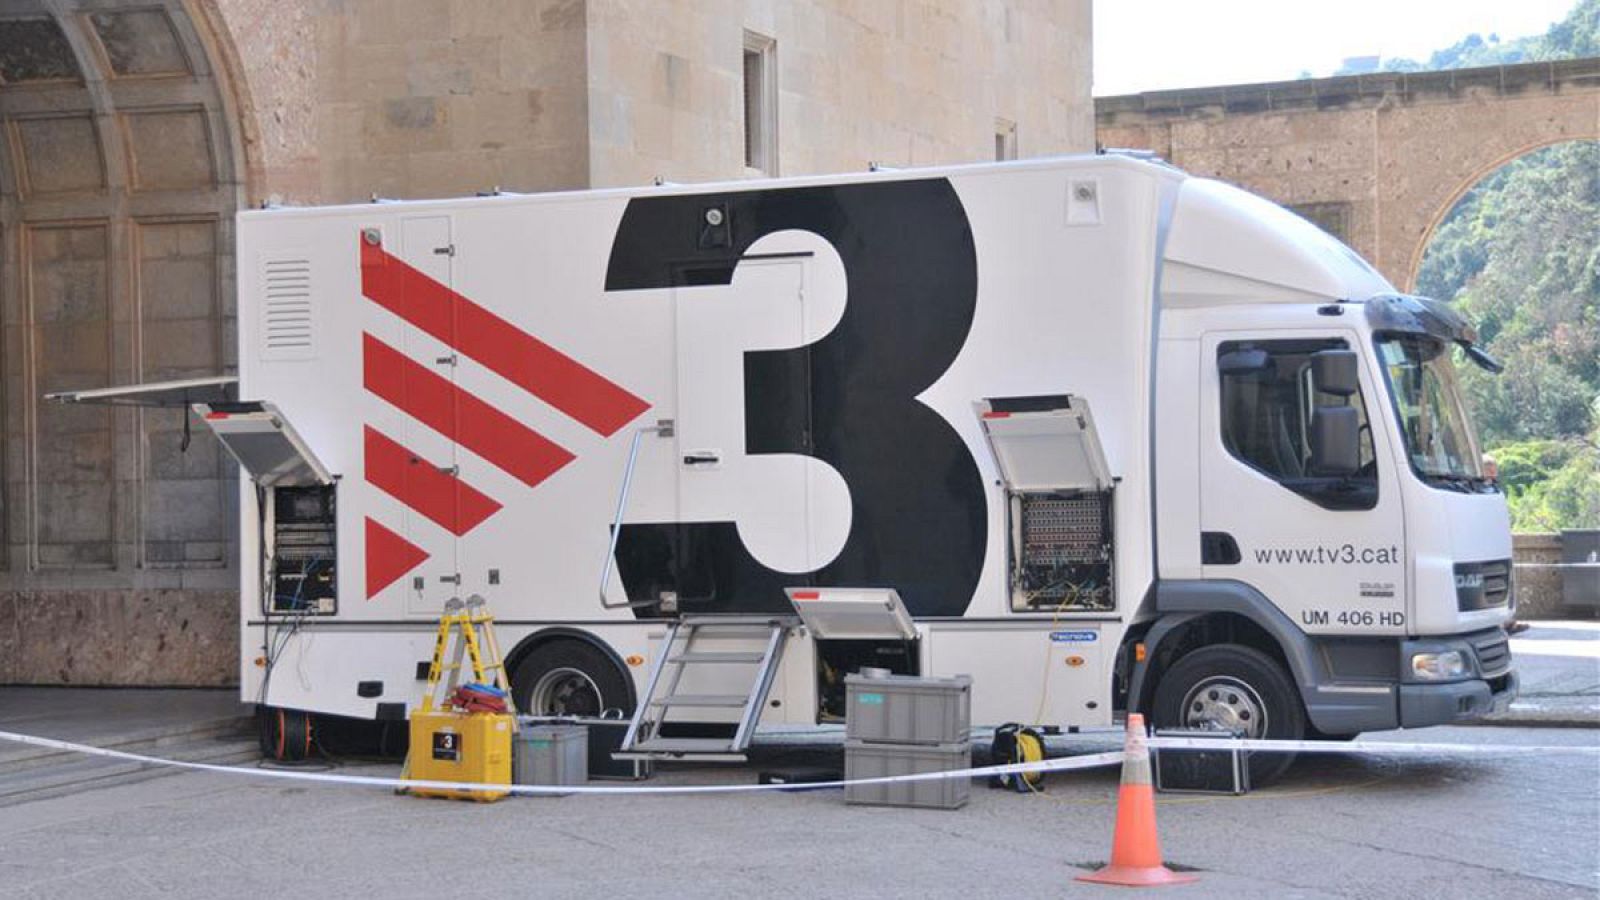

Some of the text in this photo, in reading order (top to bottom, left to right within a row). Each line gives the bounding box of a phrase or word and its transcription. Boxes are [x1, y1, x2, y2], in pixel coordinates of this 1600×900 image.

[604, 177, 988, 619] 3
[1255, 544, 1398, 564] www.tv3.cat
[1456, 574, 1484, 588] DAF
[1302, 611, 1405, 625] UM 406 HD
